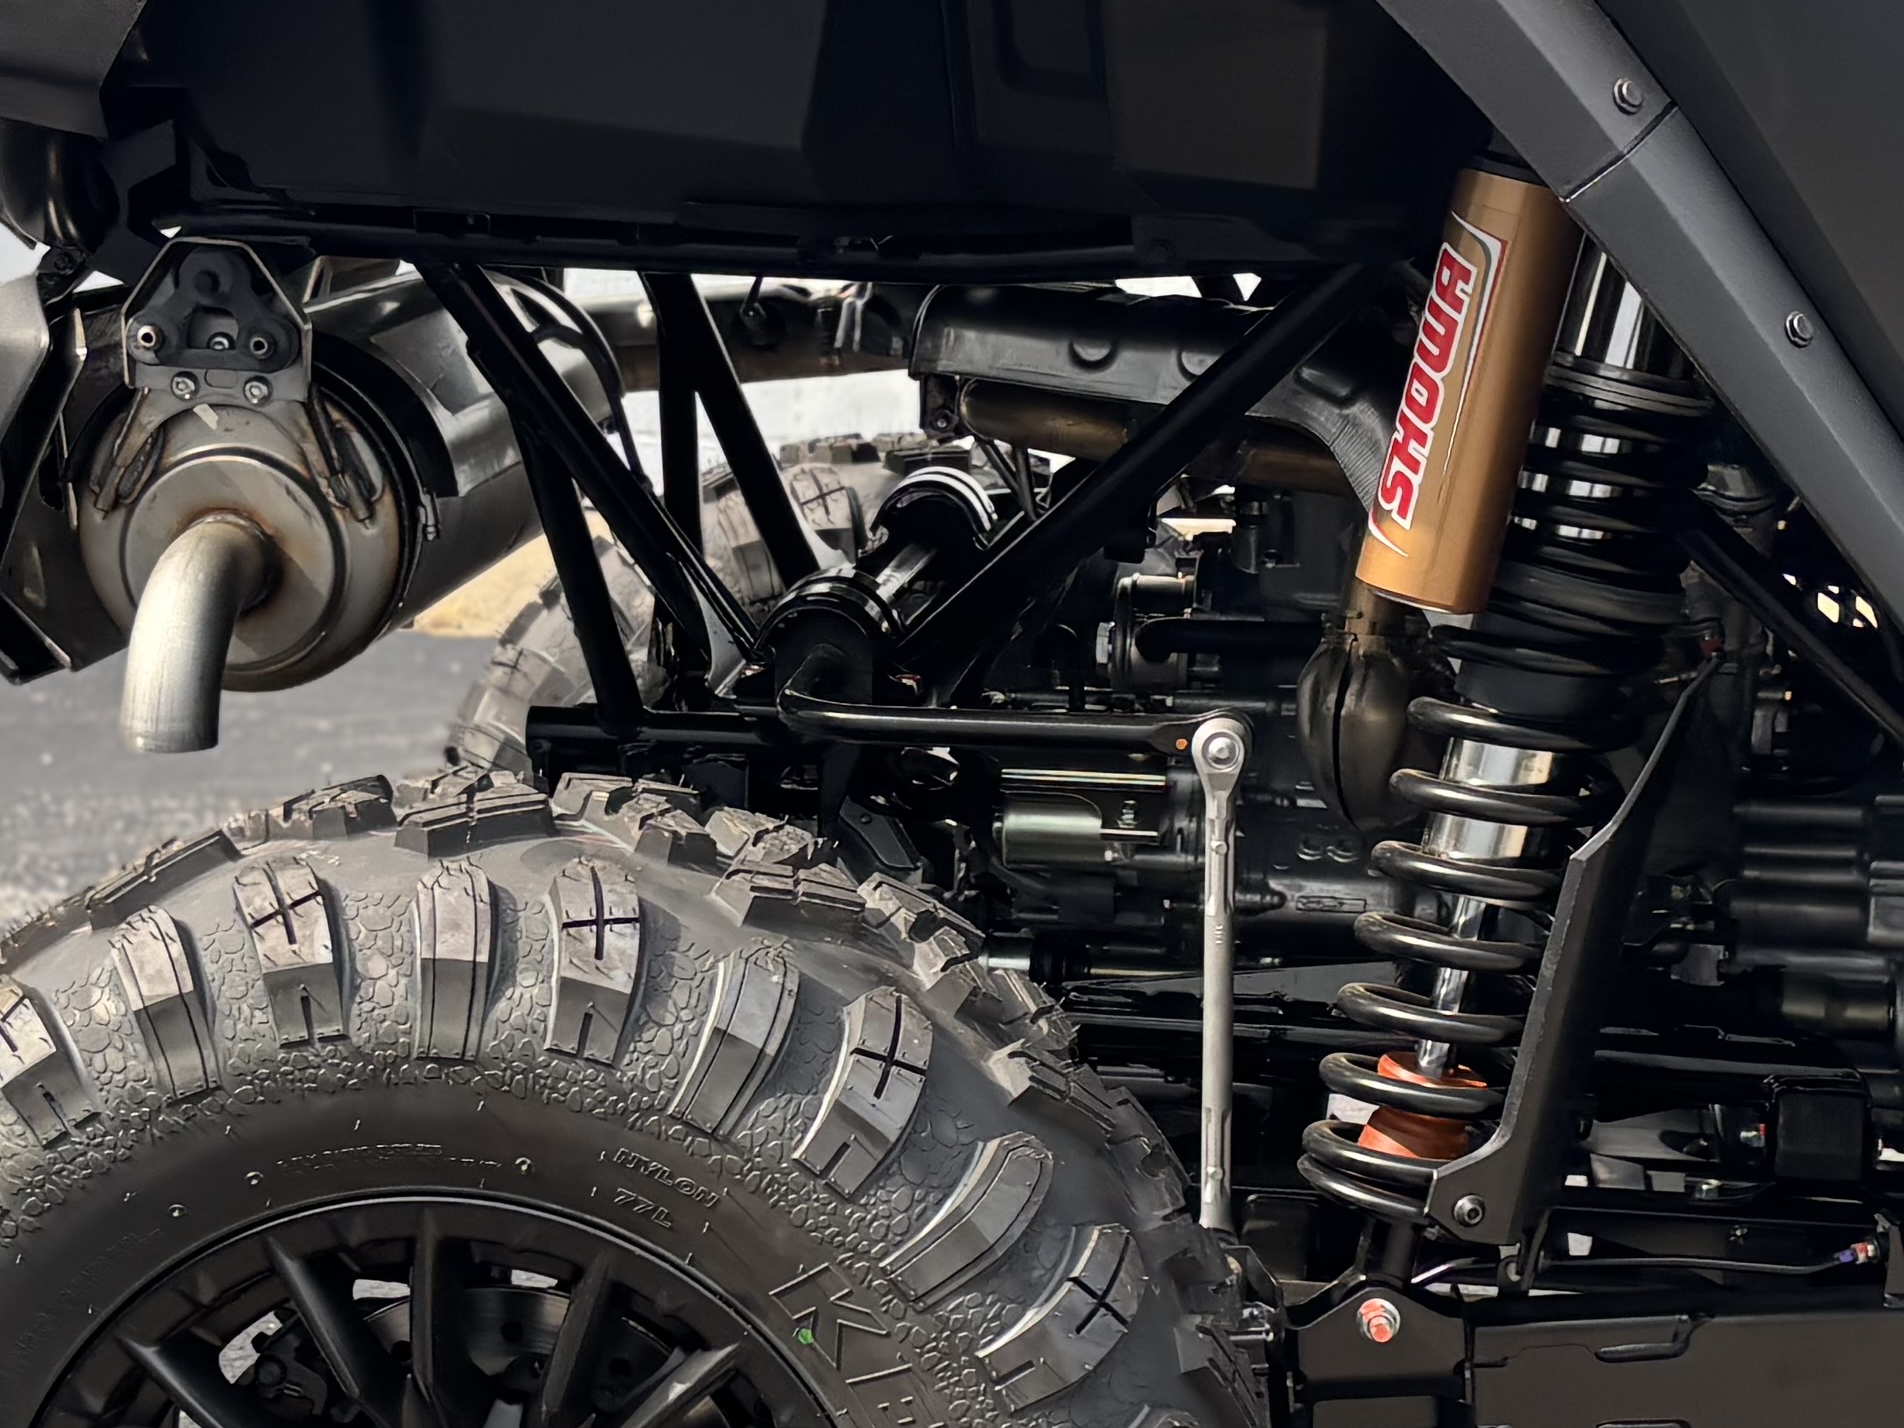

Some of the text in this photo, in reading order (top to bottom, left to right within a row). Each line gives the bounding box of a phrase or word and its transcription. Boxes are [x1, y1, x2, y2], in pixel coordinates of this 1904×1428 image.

[1378, 241, 1478, 531] SHOWA
[613, 1147, 719, 1207] NYLON
[614, 1187, 672, 1228] 77L
